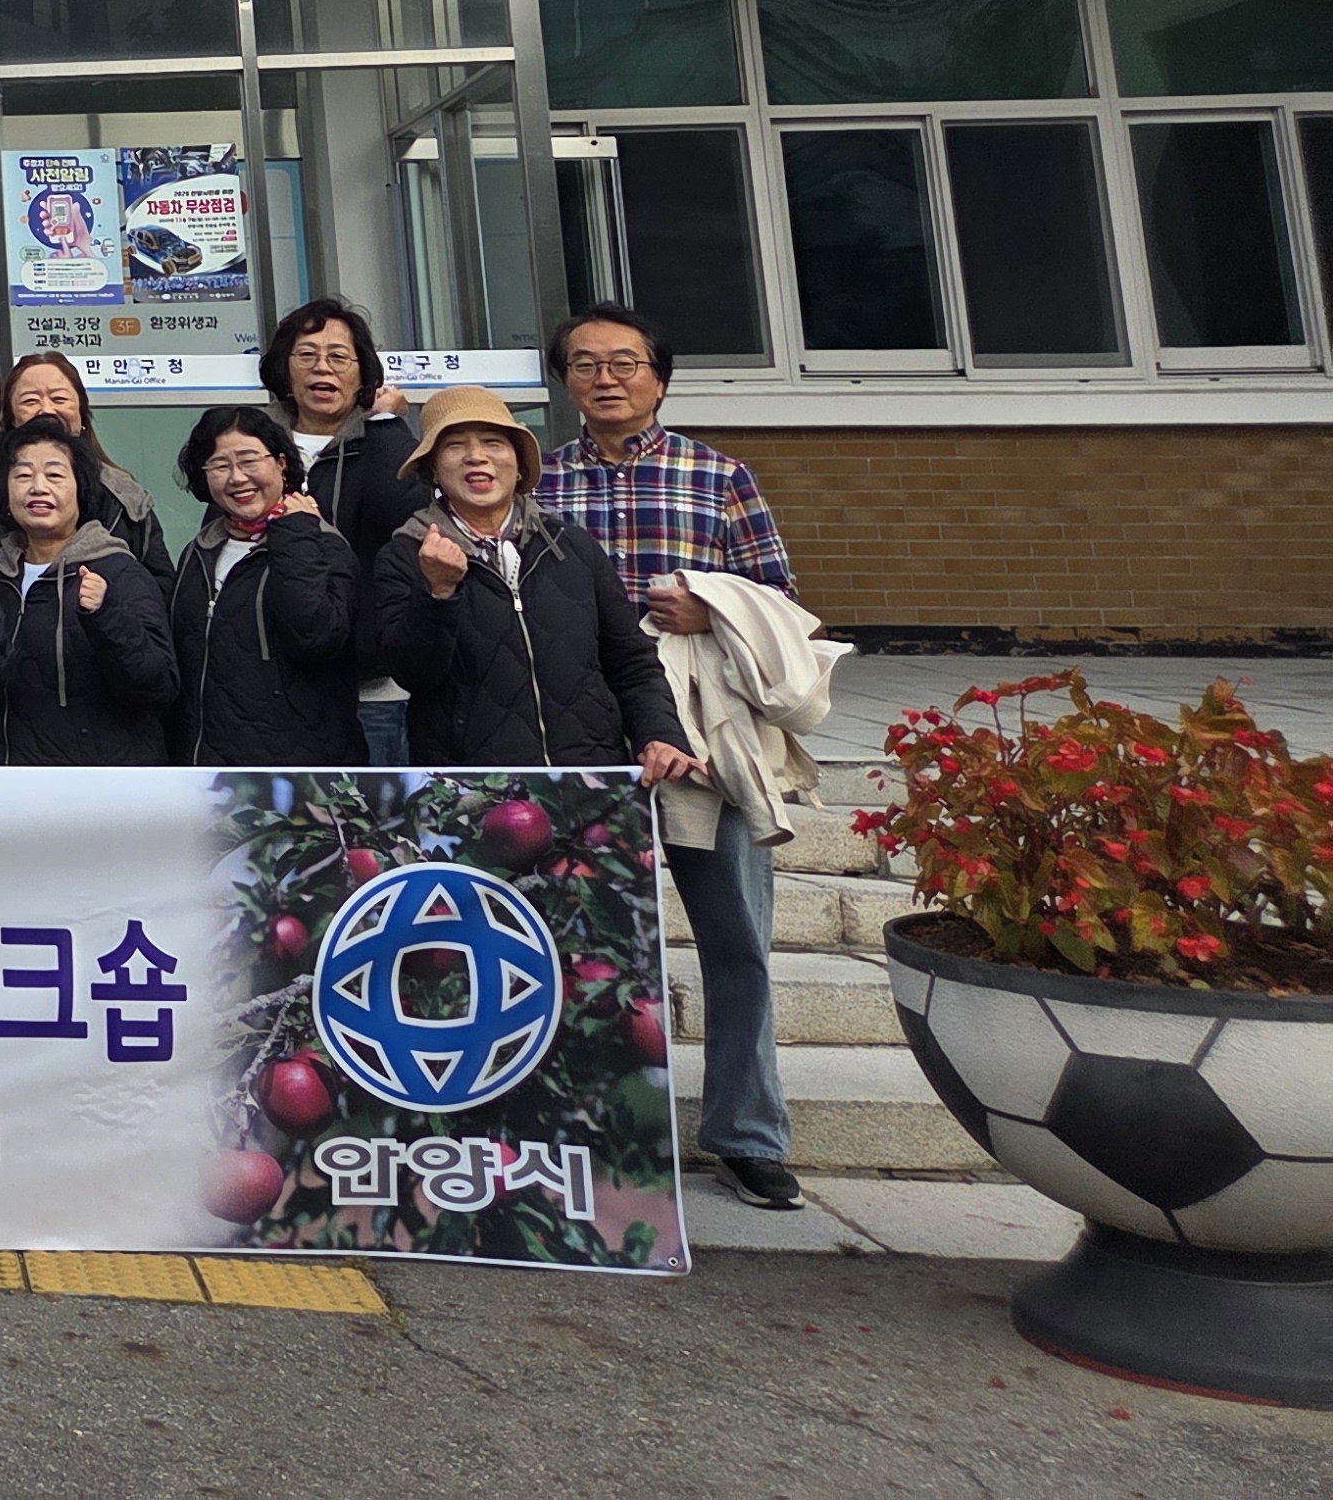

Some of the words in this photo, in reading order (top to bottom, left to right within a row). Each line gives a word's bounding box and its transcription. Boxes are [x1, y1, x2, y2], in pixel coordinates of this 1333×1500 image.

[30, 168, 89, 183] 사전알림
[146, 199, 183, 215] 자동차
[186, 198, 235, 214] 무상점검
[26, 316, 71, 332] 건설과,
[116, 320, 135, 334] 3F
[149, 316, 218, 330] 환경위생과
[35, 334, 102, 348] 교통녹지과
[234, 332, 258, 344] Wel
[86, 358, 184, 375] 만안구청
[386, 354, 461, 370] 안구청
[143, 376, 167, 385] Office
[385, 373, 417, 381] anan-Gu
[419, 373, 443, 381] Office
[314, 1137, 595, 1221] 안양시
